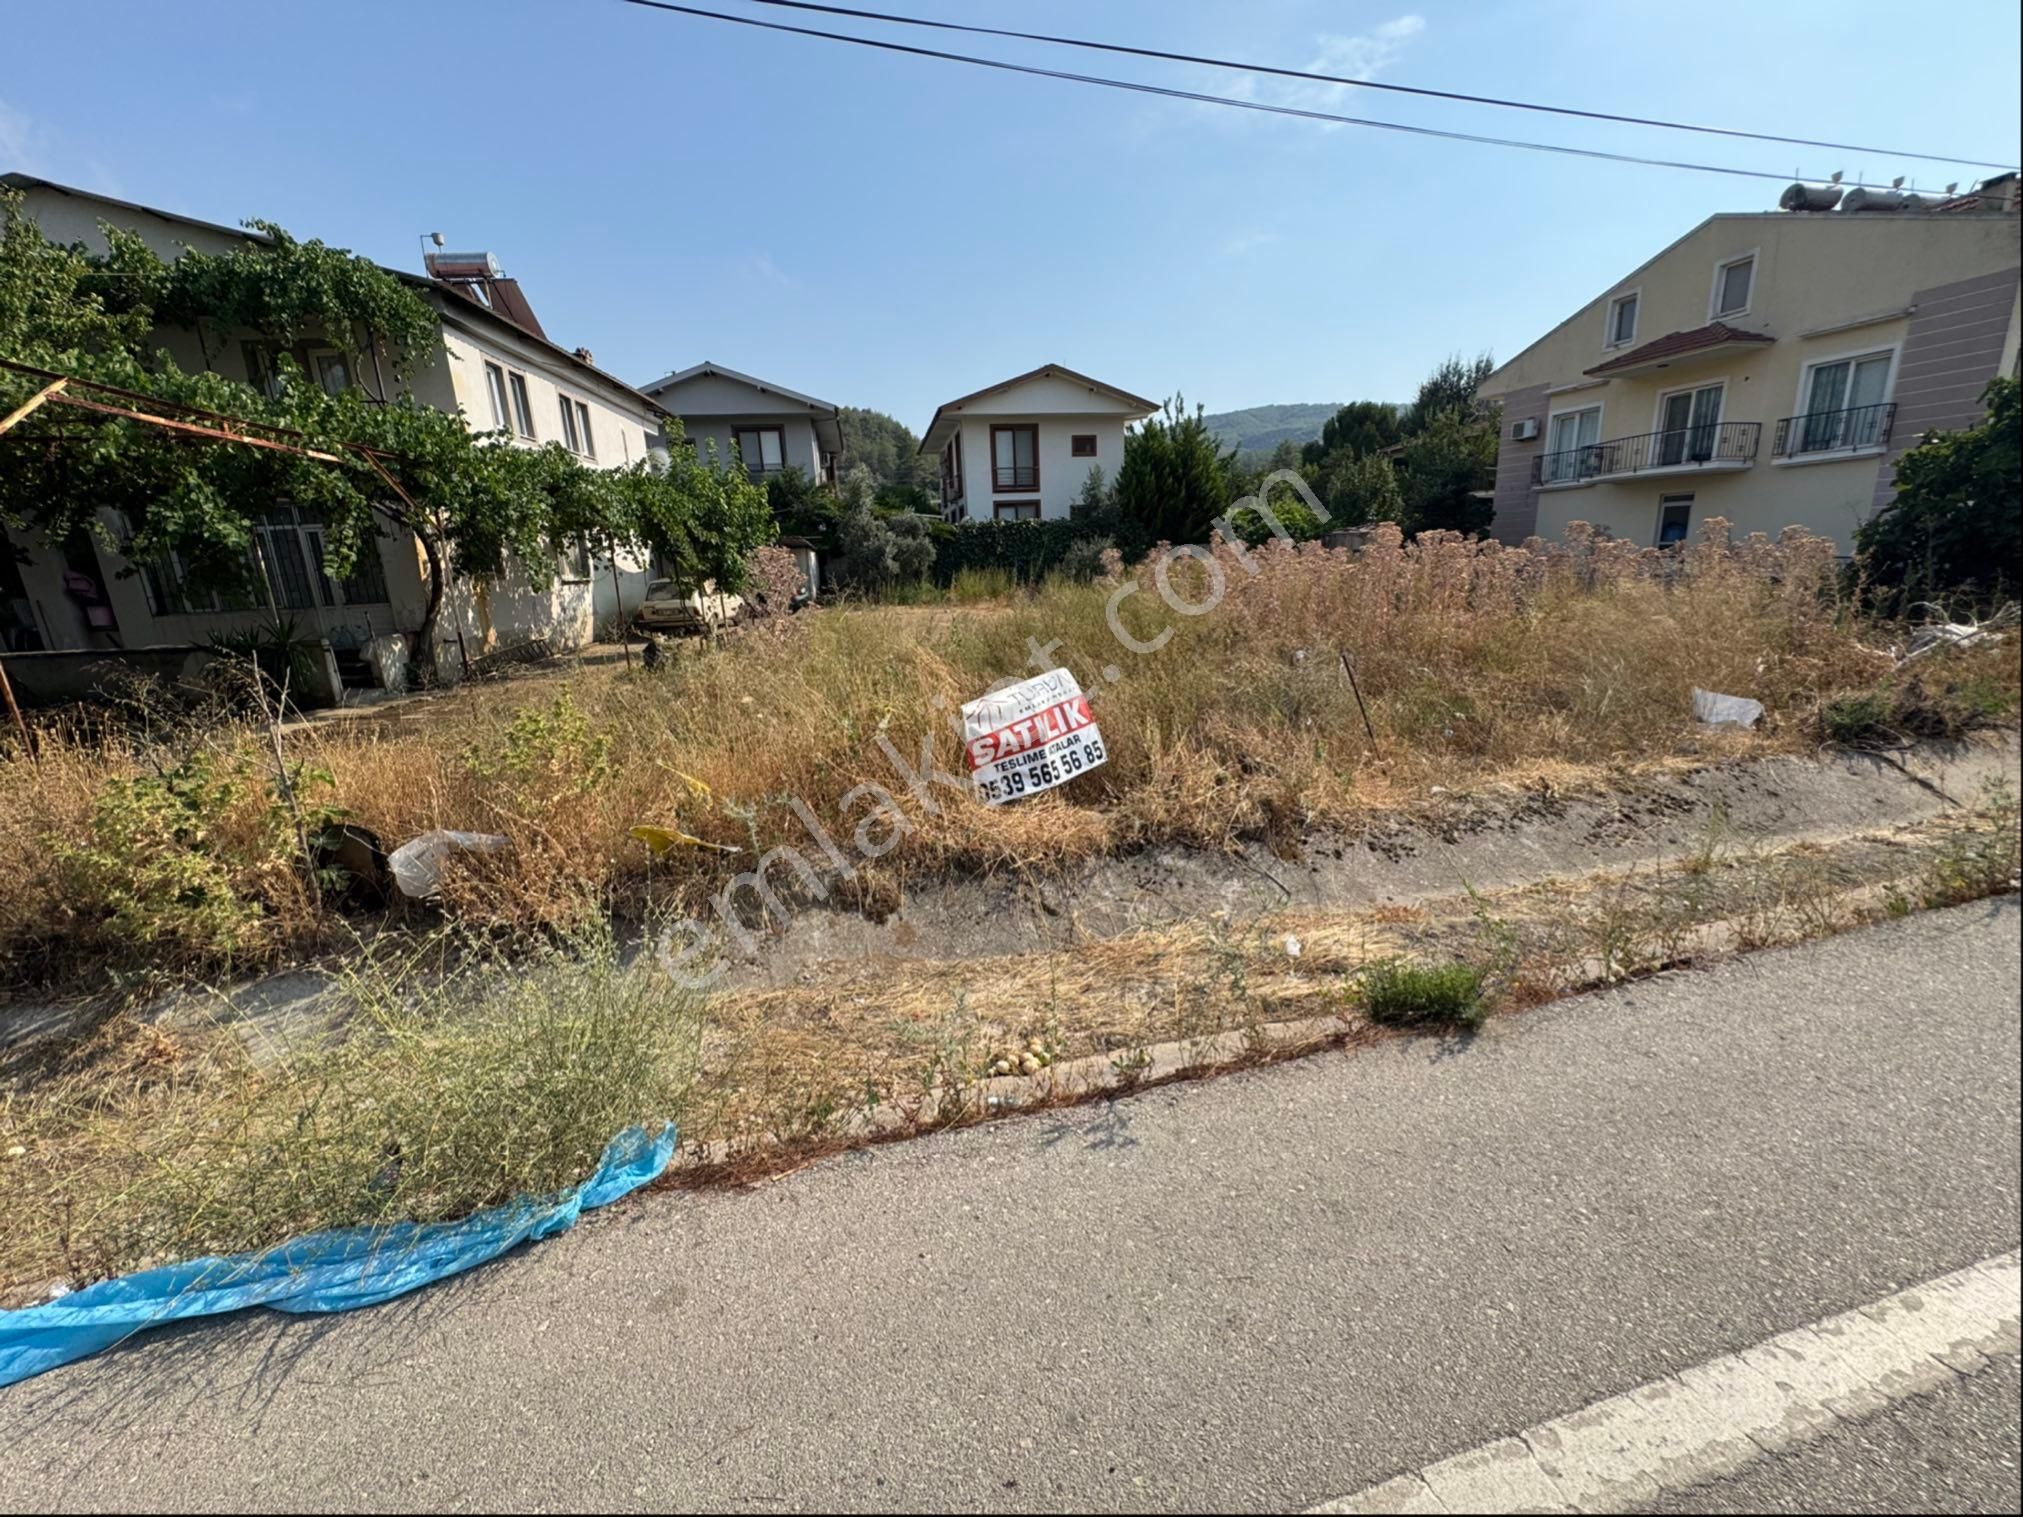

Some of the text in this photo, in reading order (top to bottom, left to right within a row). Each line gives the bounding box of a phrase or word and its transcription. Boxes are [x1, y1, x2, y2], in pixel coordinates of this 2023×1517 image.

[971, 699, 1089, 767] SATILIK
[1029, 760, 1060, 787] 565
[1061, 750, 1082, 774] 56
[1084, 740, 1103, 763] 85
